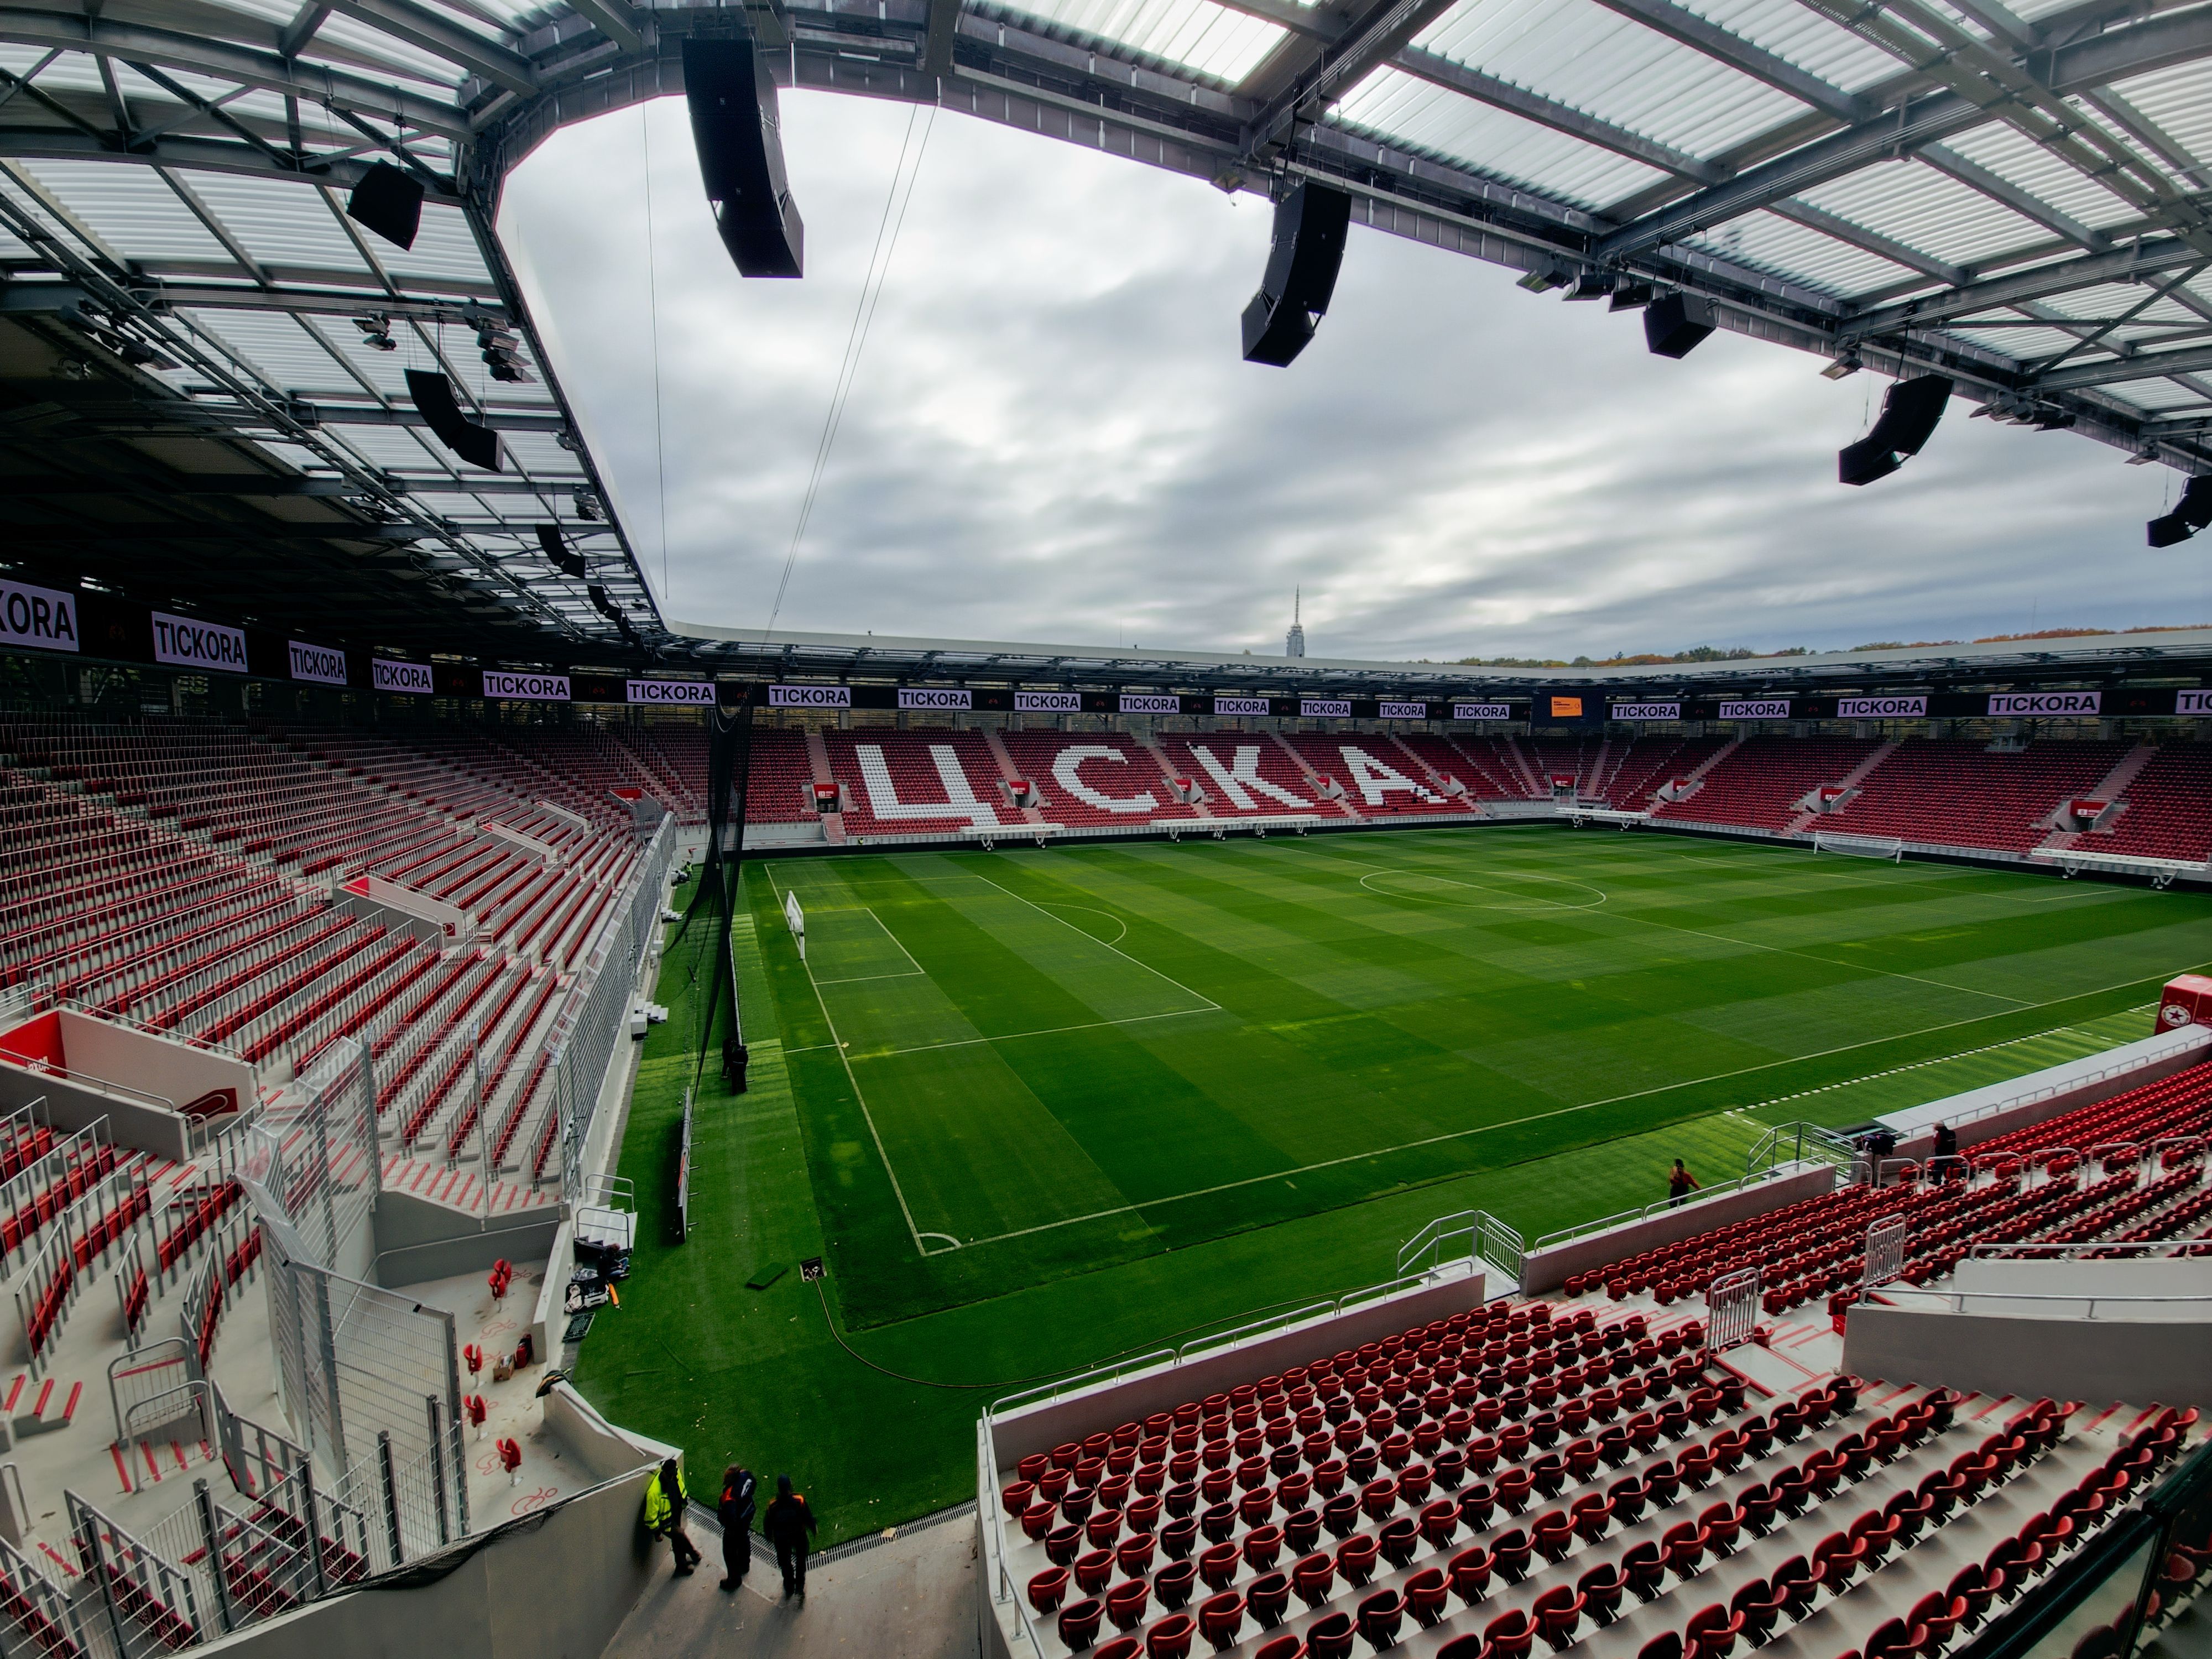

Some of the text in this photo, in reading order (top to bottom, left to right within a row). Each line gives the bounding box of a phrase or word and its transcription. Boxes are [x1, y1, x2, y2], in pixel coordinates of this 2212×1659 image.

[155, 620, 245, 665] TICKORA
[291, 648, 345, 678] TICKORA
[374, 664, 430, 688] TICKORA
[486, 676, 567, 696] TICKORA
[629, 684, 713, 701] TICKORA
[771, 689, 848, 703] TICKORA
[900, 692, 969, 706] TICKORA
[1016, 696, 1078, 708] TICKORA
[1121, 698, 1177, 710] TICKORA
[1217, 700, 1267, 713] TICKORA
[1302, 703, 1349, 714] TICKORA
[1381, 705, 1424, 716] TICKORA
[1721, 703, 1787, 716] TICKORA
[1841, 700, 1923, 714] TICKORA
[1992, 696, 2096, 711] TICKORA
[1455, 707, 1507, 717] TICKORA
[1614, 706, 1678, 717] TICKORA
[855, 744, 1447, 826] ЦСКА
